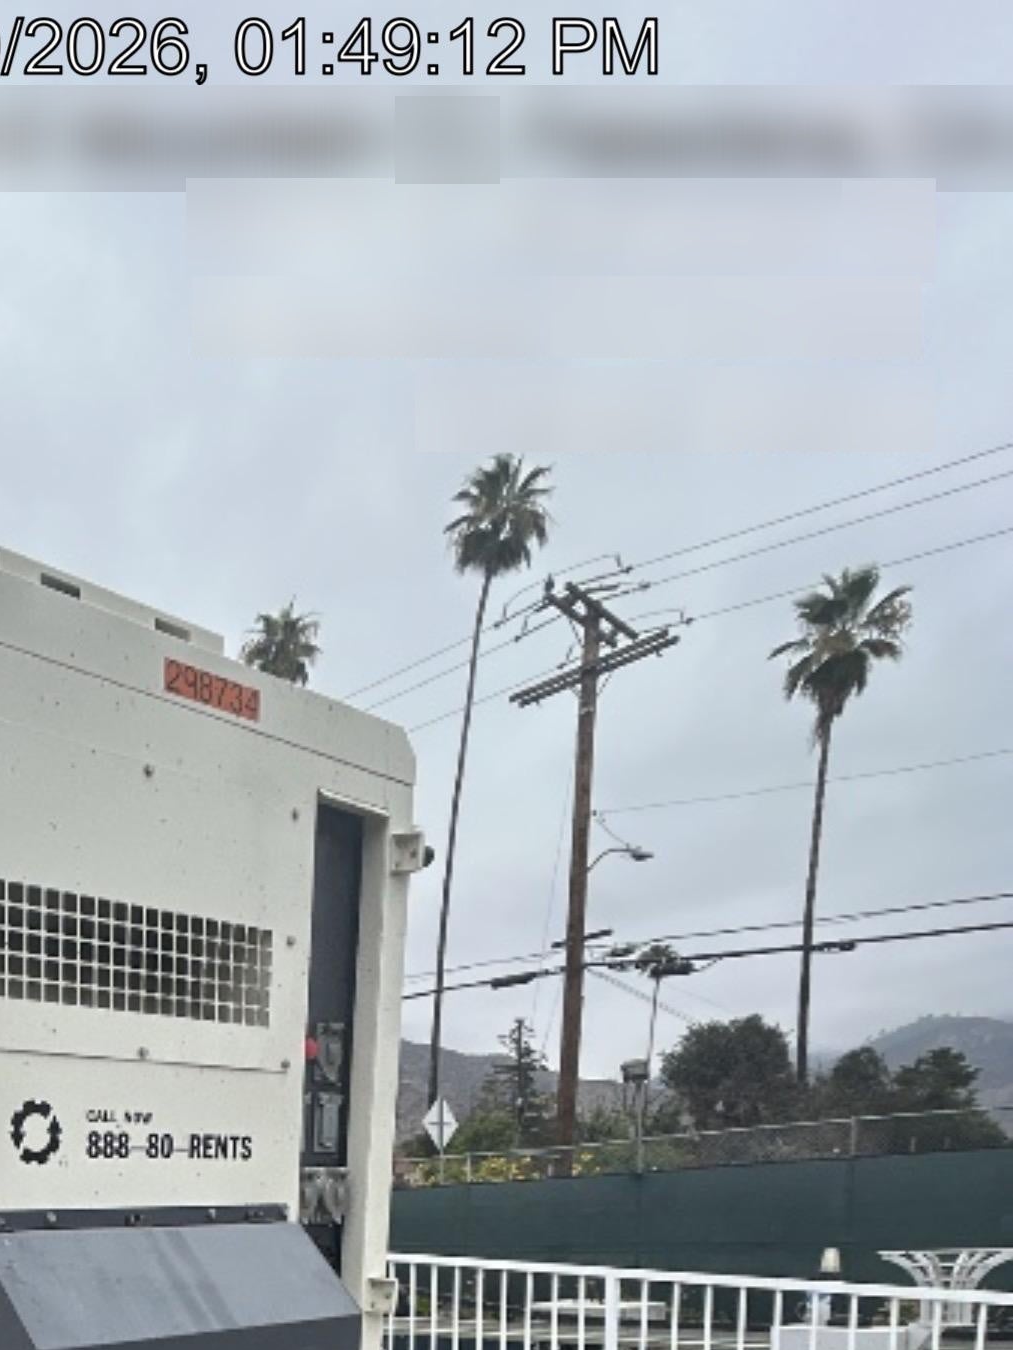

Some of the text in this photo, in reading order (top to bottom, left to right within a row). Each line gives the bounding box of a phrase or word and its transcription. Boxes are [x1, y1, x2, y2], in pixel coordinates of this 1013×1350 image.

[166, 658, 259, 720] 298734
[86, 1109, 117, 1123] CALL
[86, 1131, 252, 1160] 888-80-RENTS
